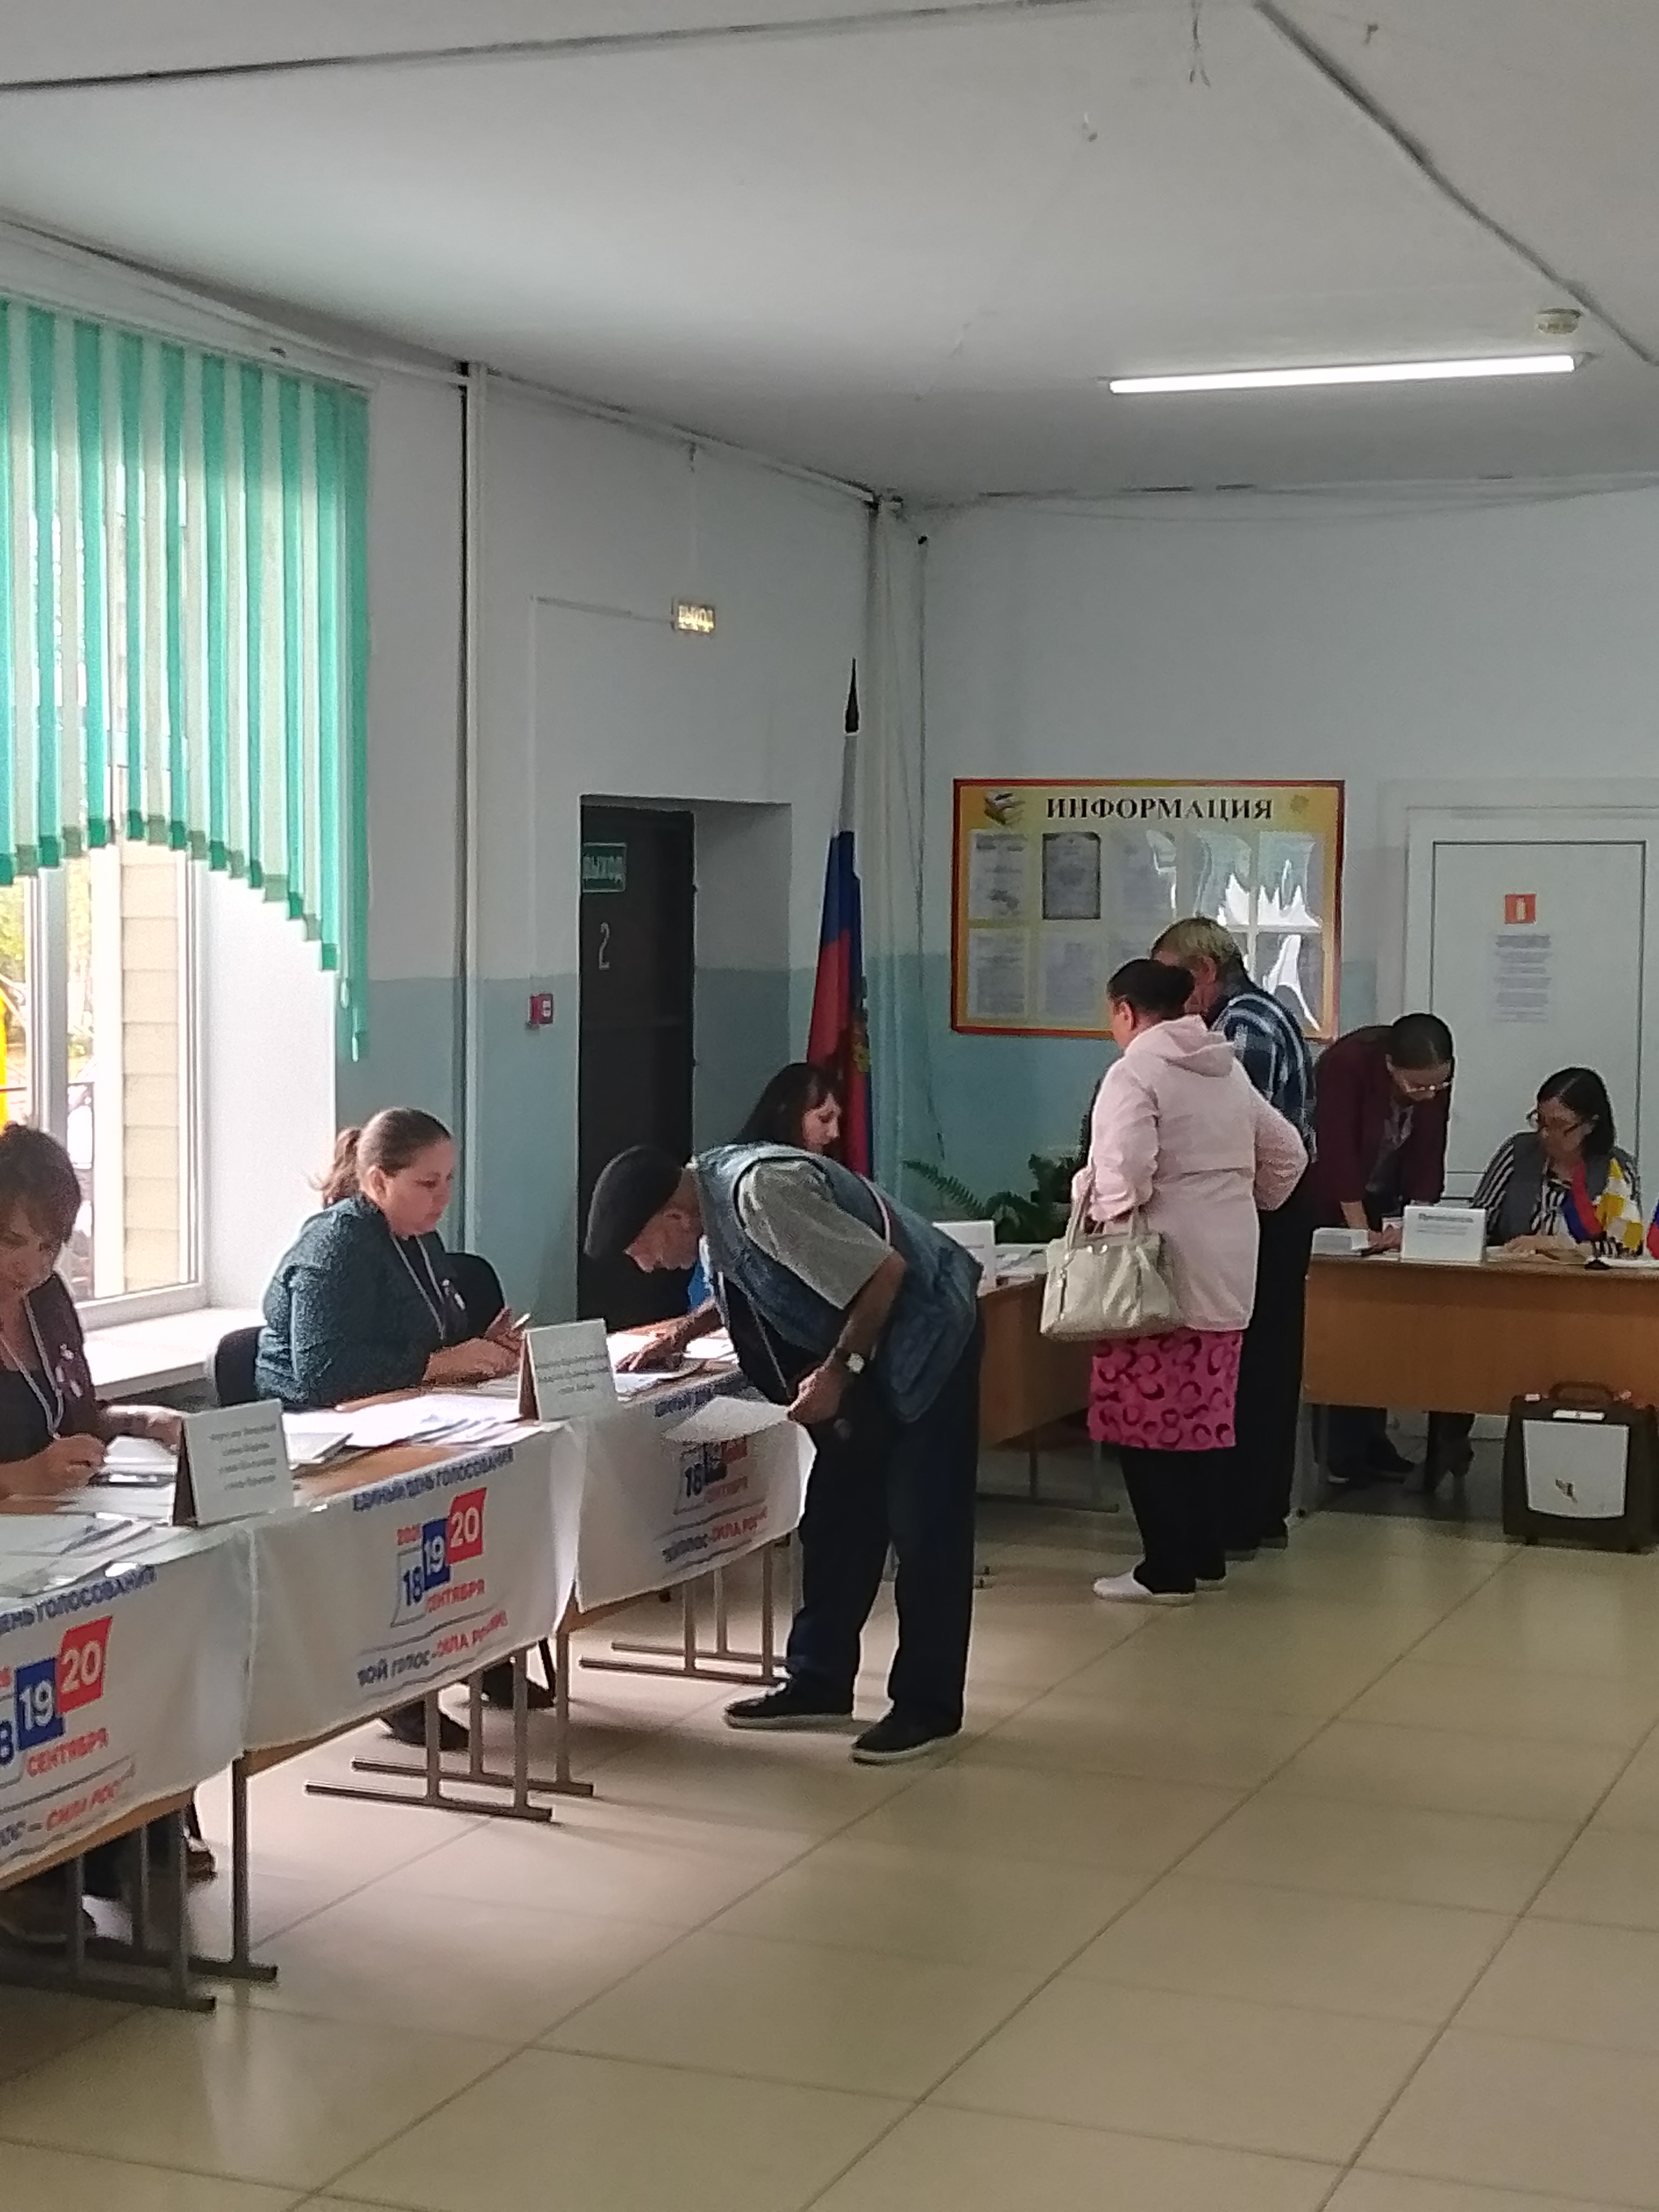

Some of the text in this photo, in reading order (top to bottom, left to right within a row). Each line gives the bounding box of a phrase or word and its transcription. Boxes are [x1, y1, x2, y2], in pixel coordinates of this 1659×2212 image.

[1047, 798, 1273, 822] ИНФОРМАЦИЯ
[599, 922, 610, 970] 2
[685, 1462, 703, 1499] 18
[451, 1506, 480, 1548] 20
[425, 1535, 444, 1576] 19
[403, 1566, 423, 1606] 18
[60, 1640, 102, 1694] 20
[19, 1680, 54, 1730] 19
[0, 1721, 14, 1765] 8
